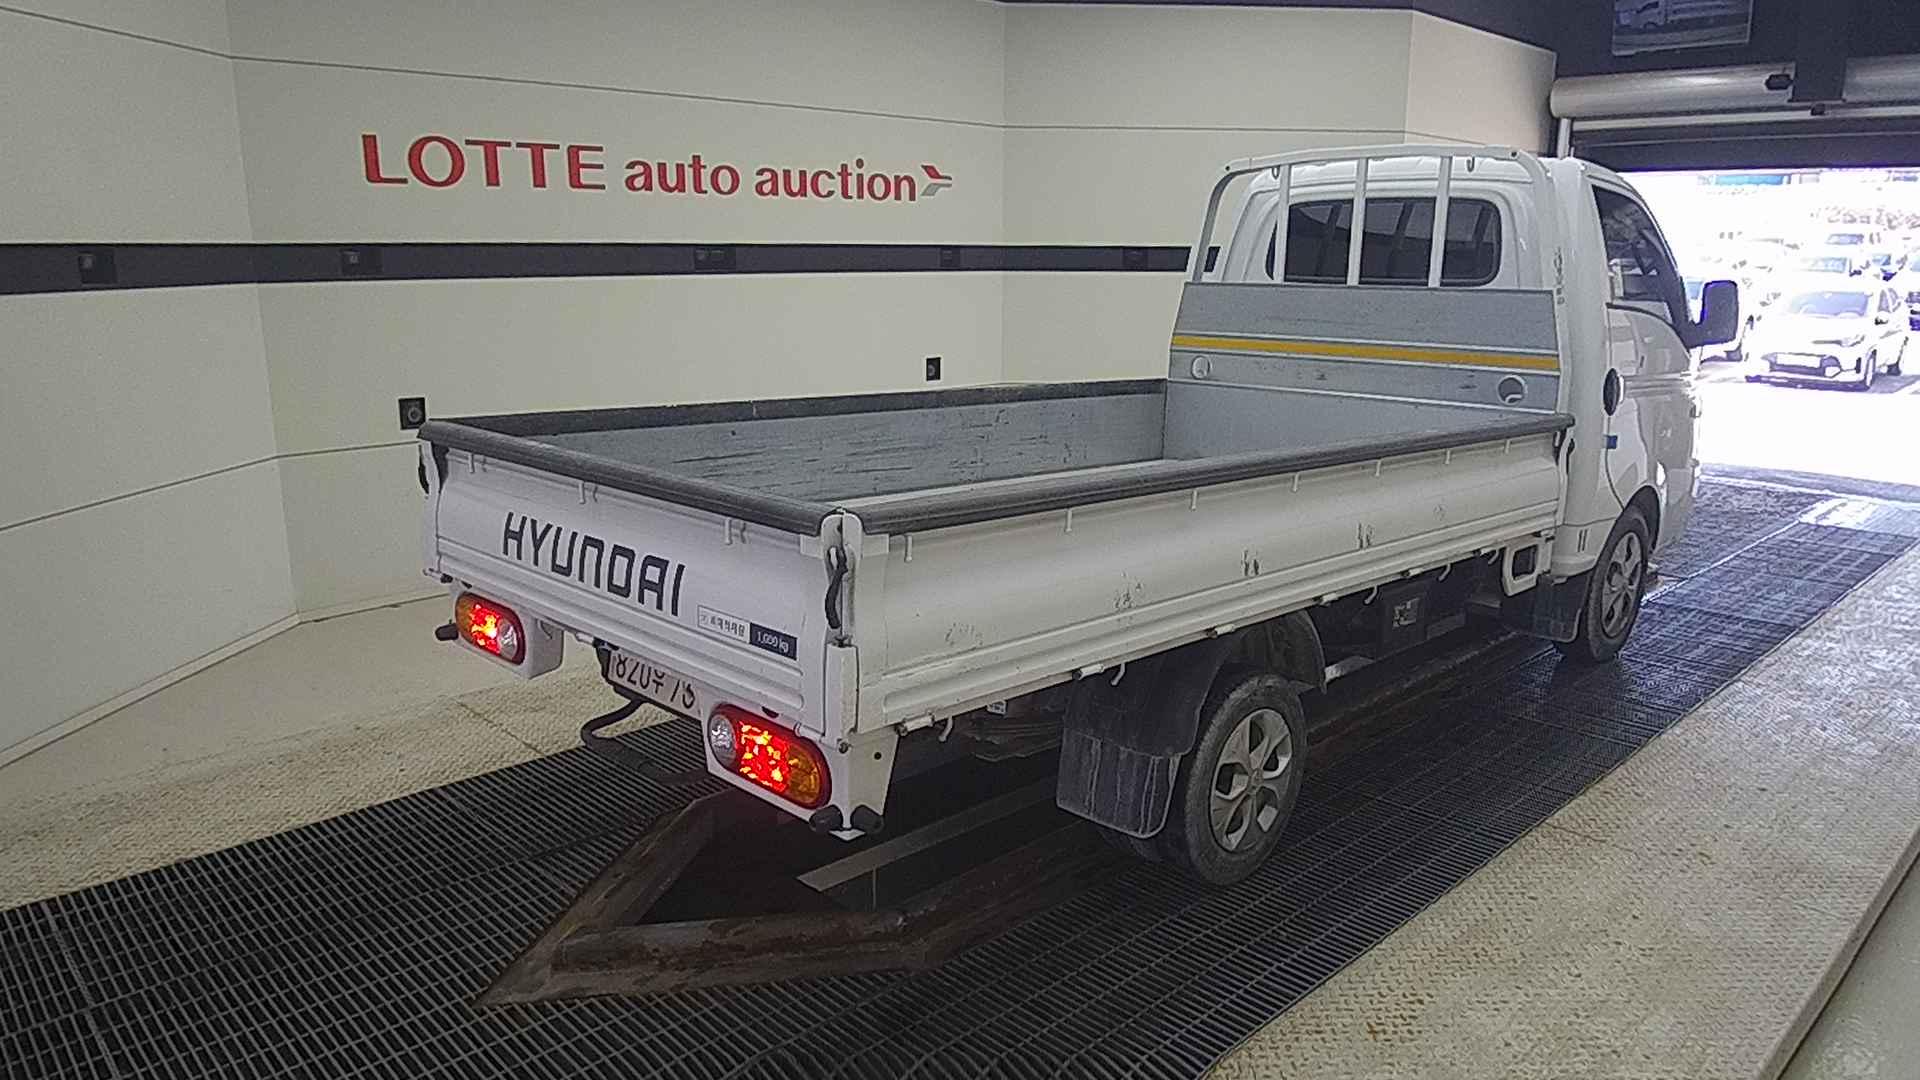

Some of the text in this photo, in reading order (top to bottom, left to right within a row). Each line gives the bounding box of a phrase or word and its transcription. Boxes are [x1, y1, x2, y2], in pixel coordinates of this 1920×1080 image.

[361, 134, 915, 202] LOTTE auto auction
[504, 511, 685, 617] HYUNDAI
